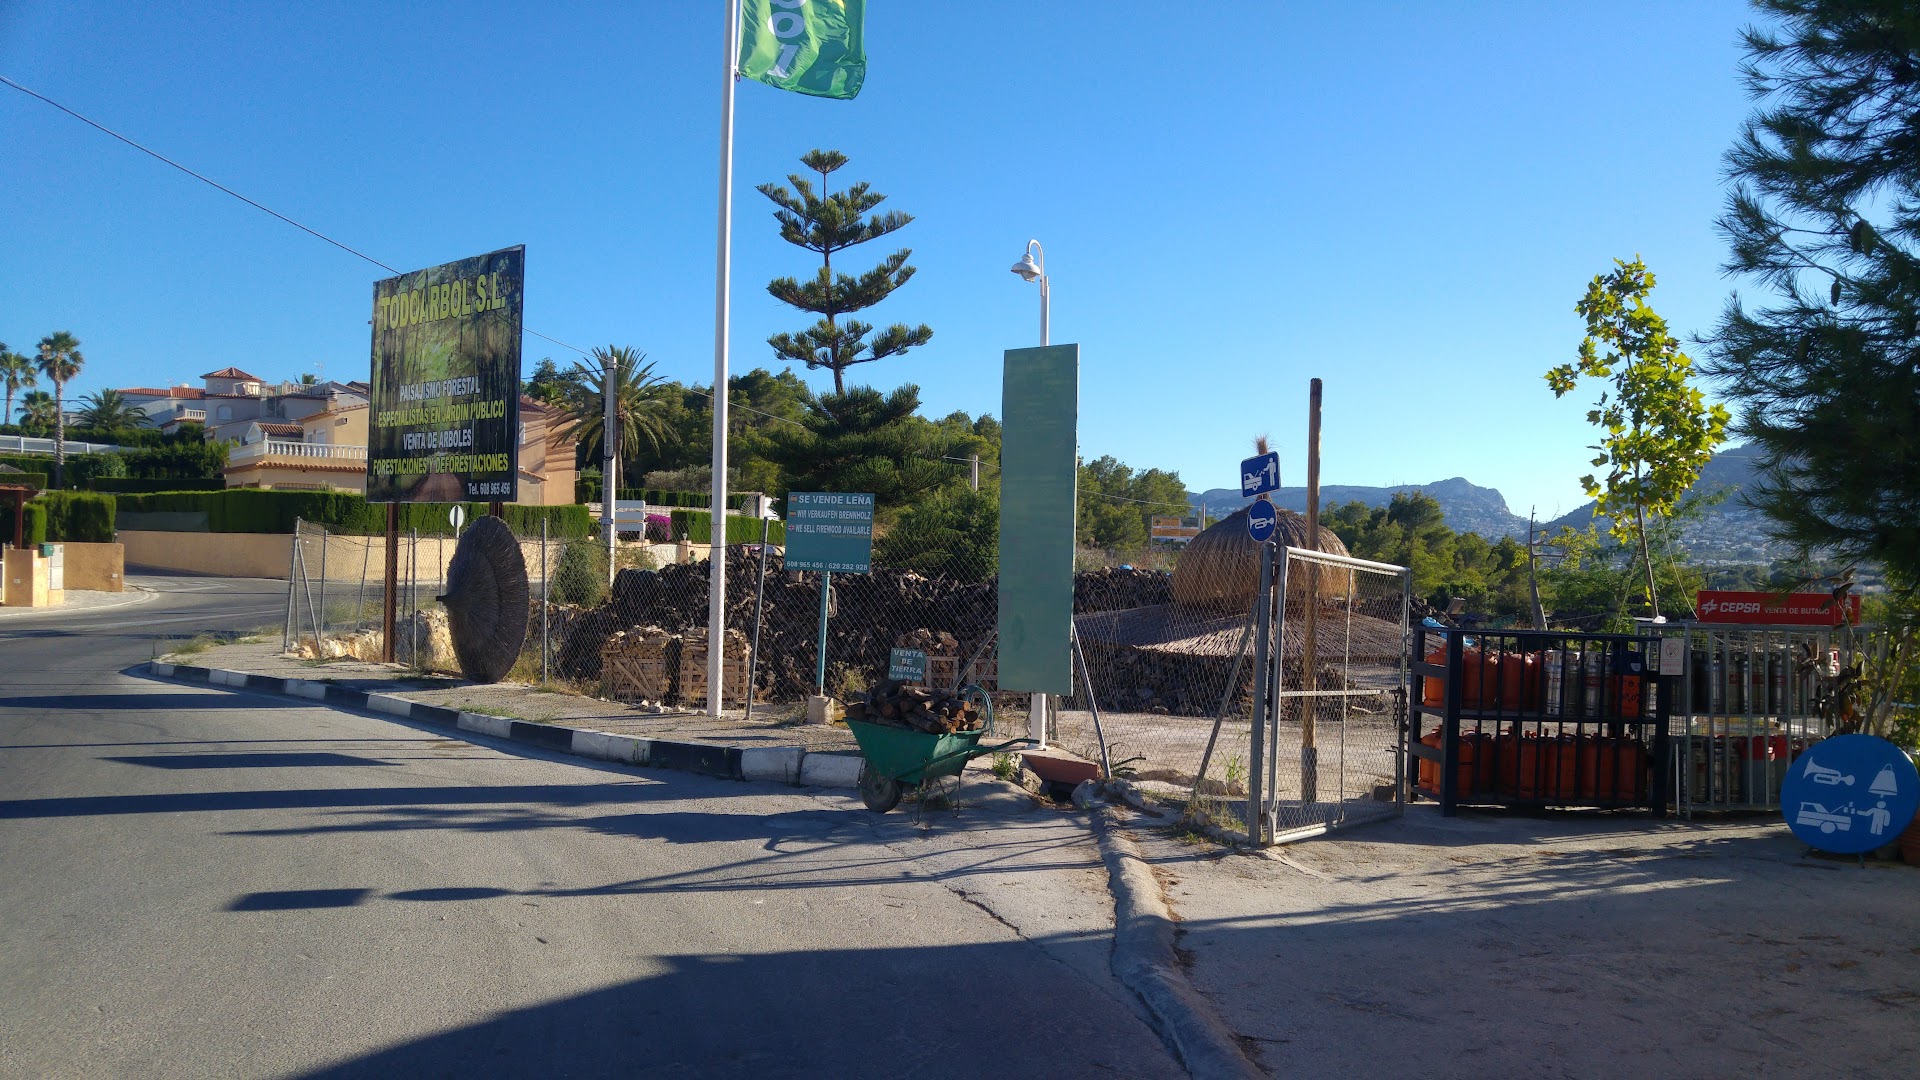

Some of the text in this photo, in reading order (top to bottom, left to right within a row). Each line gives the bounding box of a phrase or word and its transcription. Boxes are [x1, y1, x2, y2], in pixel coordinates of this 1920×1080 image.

[381, 272, 506, 331] TODOARBOL S.L.
[400, 376, 480, 402] PAISAJISMO FORESTAL
[378, 408, 428, 427] ESPECIALISTAS
[430, 406, 440, 423] EN
[403, 429, 471, 450] VENTA DE ARBOLES
[373, 453, 508, 475] FORESTACIONES Y DEFORESTACIONES
[468, 482, 478, 495] Tel.
[480, 482, 489, 495] 608
[490, 482, 500, 495] 965
[799, 494, 871, 505] SE VENDE LEÑA
[797, 509, 871, 520] WIR VERKAUFEN BRENNHOLZ
[795, 524, 803, 533] WE
[803, 524, 815, 533] SELL
[842, 525, 870, 535] AVAILABLE
[786, 560, 798, 568] 608
[828, 562, 841, 570] 620
[855, 563, 868, 571] 928
[1719, 602, 1761, 613] CEPSA
[1764, 607, 1788, 615] VENTA
[1788, 607, 1799, 615] DE
[893, 650, 923, 658] VENTA
[891, 666, 922, 674] TIERRA
